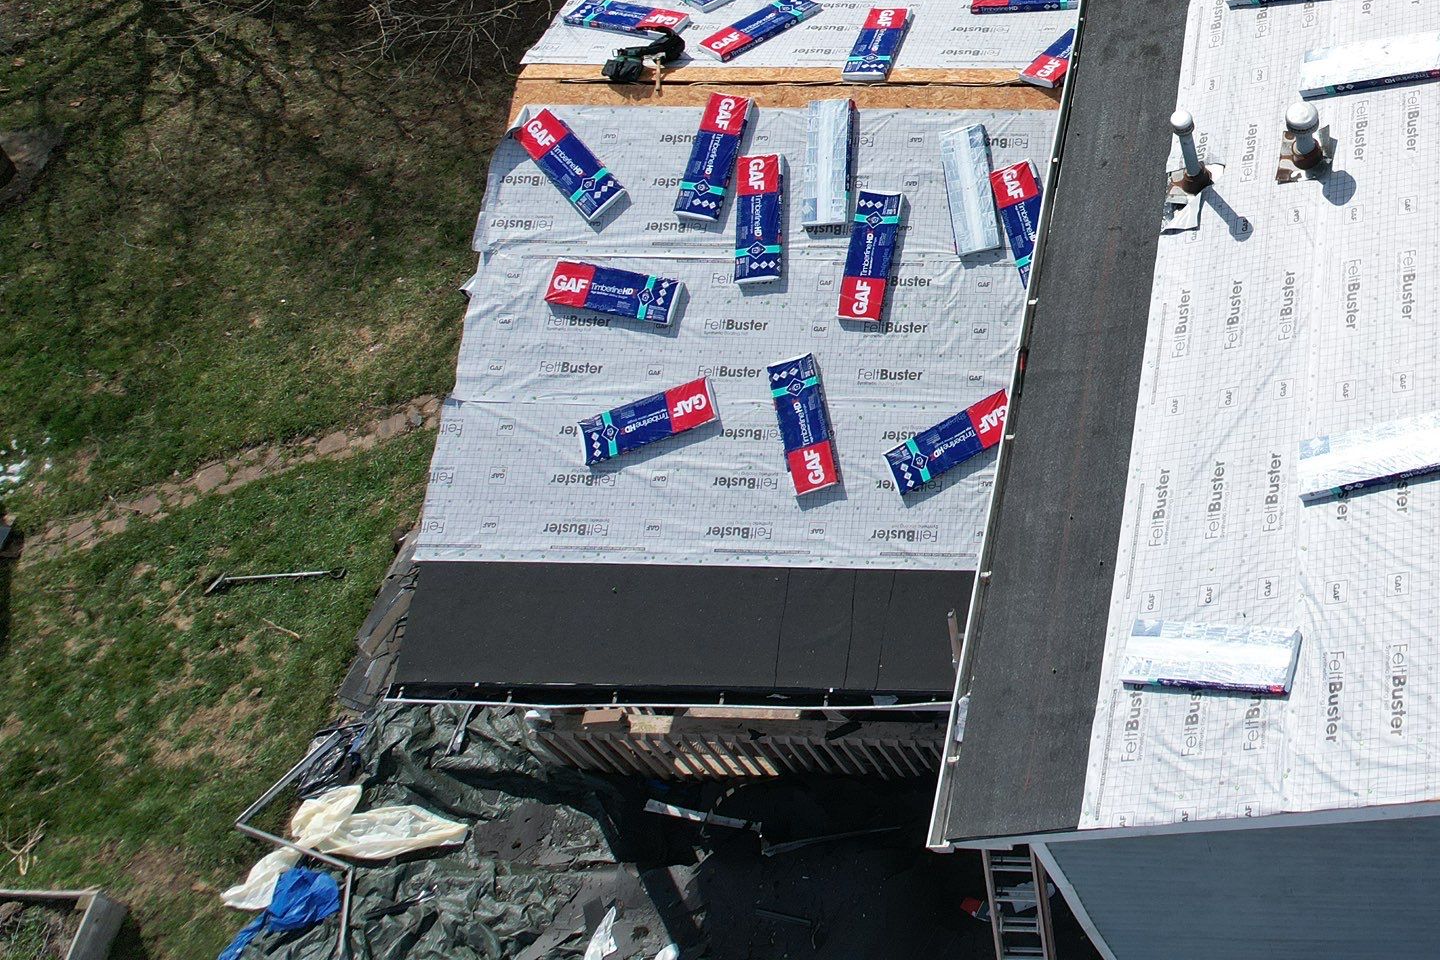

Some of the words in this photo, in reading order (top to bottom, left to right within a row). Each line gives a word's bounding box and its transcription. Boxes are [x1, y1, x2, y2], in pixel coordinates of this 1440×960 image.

[645, 15, 679, 24] GAF
[878, 9, 895, 27] GAF
[711, 31, 742, 49] GAF
[1037, 59, 1061, 76] GAF
[714, 98, 735, 131] GAF
[527, 119, 556, 149] GAF
[1356, 100, 1369, 162] FeltBuster
[1241, 123, 1258, 183] FeltBuster
[748, 158, 765, 191] GAF
[1002, 169, 1024, 201] GAF
[491, 219, 553, 231] FeltBuster
[553, 275, 589, 293] GAF
[852, 280, 872, 315] GAF
[1347, 259, 1361, 330] FeltBuster
[1224, 280, 1242, 350] FeltBuster
[1278, 271, 1295, 341] FeltBuster
[547, 315, 611, 329] FeltBuster
[704, 318, 768, 332] FeltBuster
[864, 322, 927, 333] FeltBuster
[1172, 289, 1191, 358] FeltBuster
[539, 361, 603, 374] FeltBuster
[697, 365, 762, 378] FeltBuster
[858, 369, 922, 380] FeltBuster
[672, 393, 707, 418] GAF
[979, 404, 1008, 434] GAF
[808, 450, 825, 485] GAF
[551, 472, 616, 487] FeltBuster
[713, 477, 778, 489] FeltBuster
[1262, 452, 1282, 533] FeltBuster
[1149, 468, 1171, 547] FeltBuster
[542, 522, 609, 536] FeltBuster
[706, 527, 772, 539] FeltBuster
[871, 528, 938, 542] FeltBuster
[1263, 579, 1272, 594] GAF
[1331, 584, 1340, 601] GAF
[1394, 576, 1403, 592] GAF
[1205, 587, 1214, 602] GAF
[1326, 651, 1344, 742] FeltBuster
[1391, 644, 1407, 736] FeltBuster
[1121, 683, 1143, 762] FeltBuste
